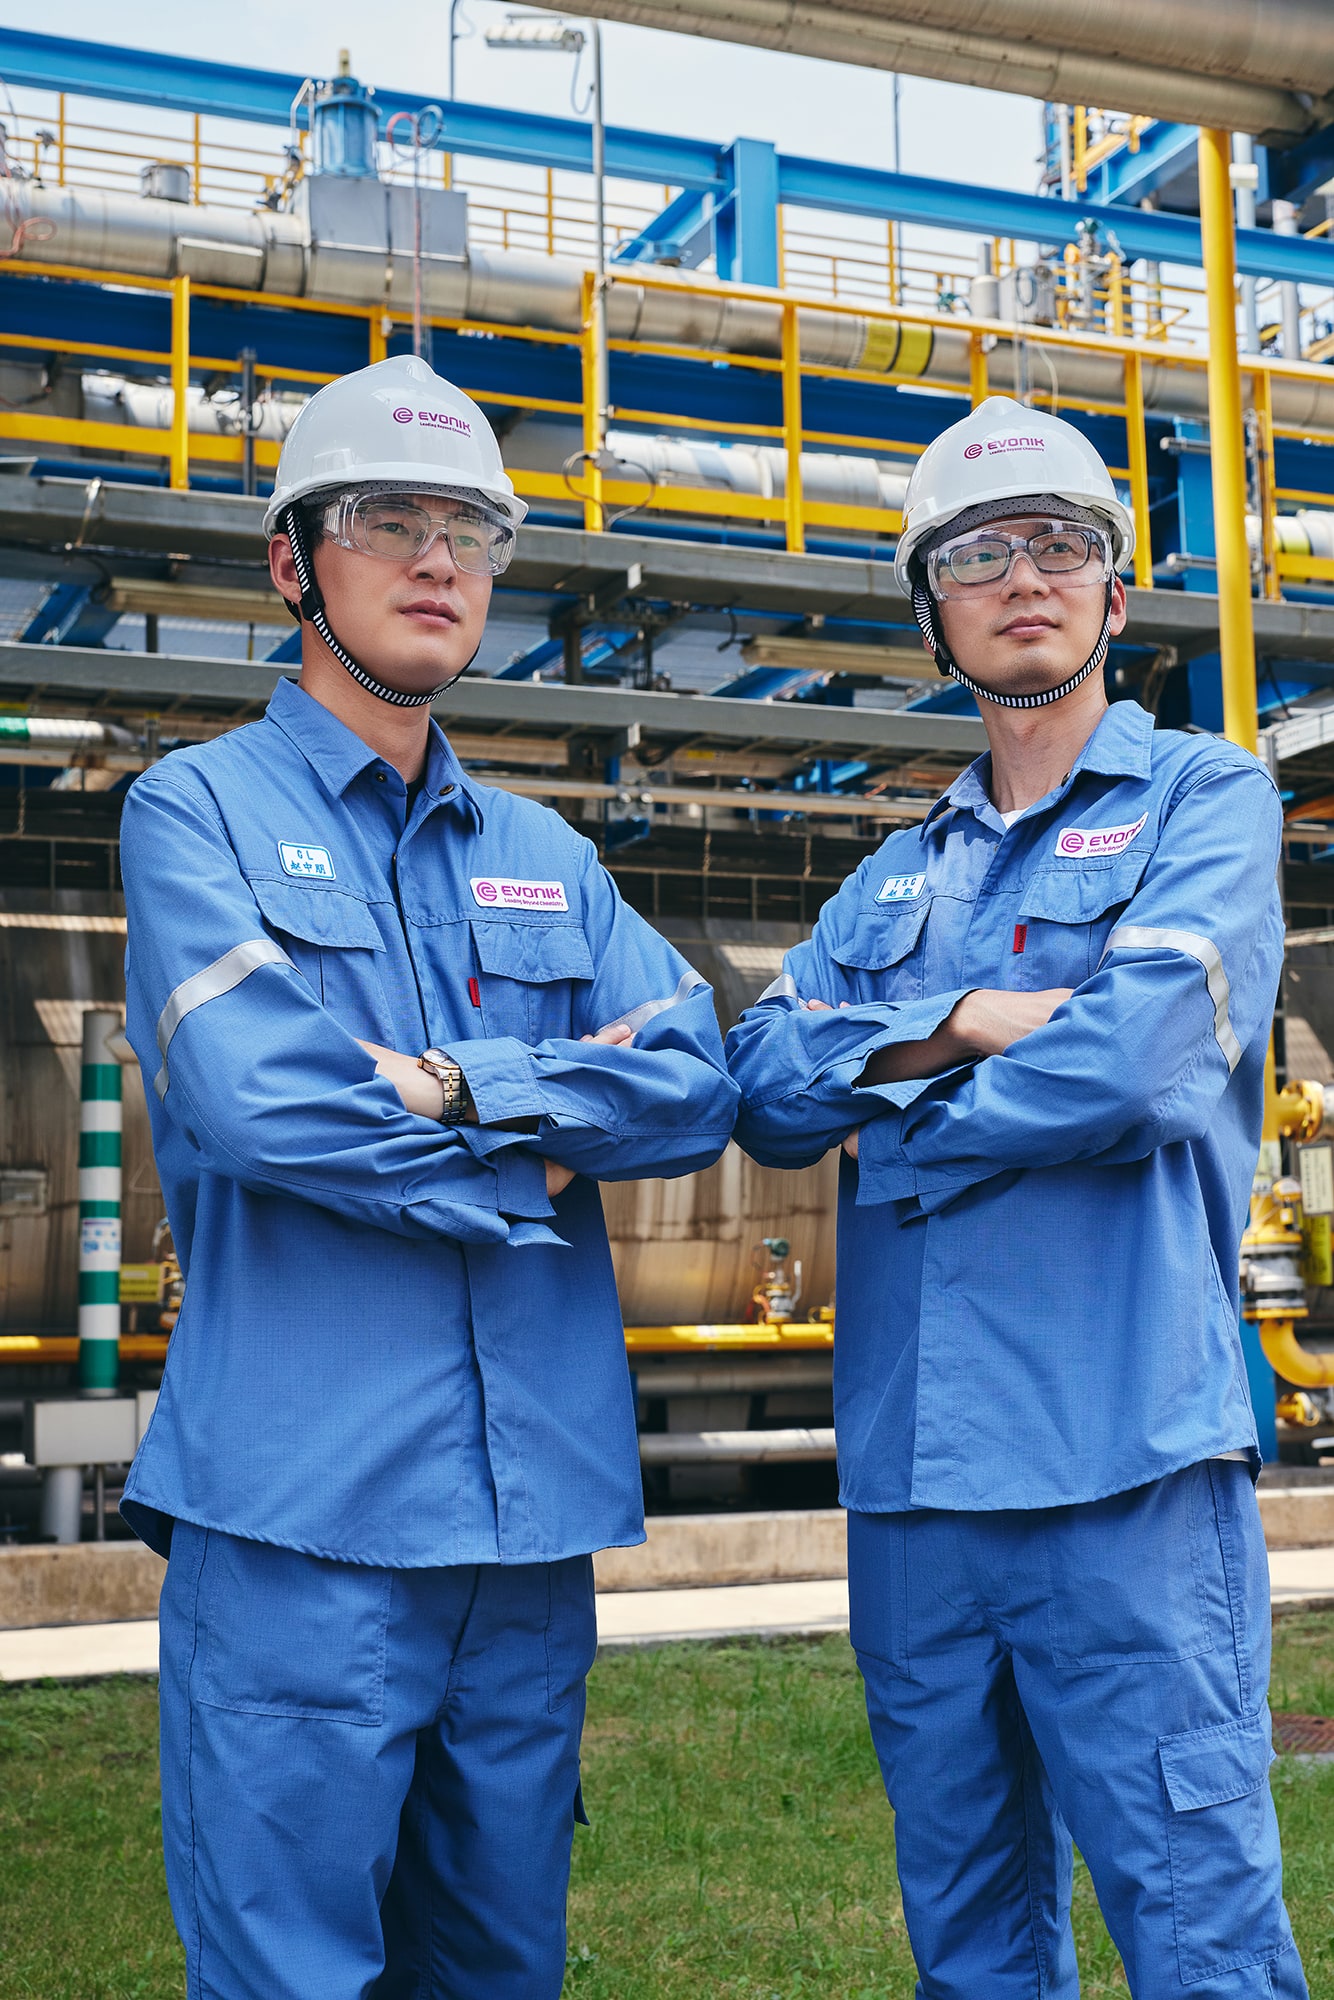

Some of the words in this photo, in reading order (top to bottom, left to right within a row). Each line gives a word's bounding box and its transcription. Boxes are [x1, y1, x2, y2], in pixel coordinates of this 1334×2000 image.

[418, 411, 471, 433] EVONIK
[987, 437, 1045, 450] EVONIK
[1090, 819, 1144, 846] EVON
[501, 885, 562, 899] EVONIK
